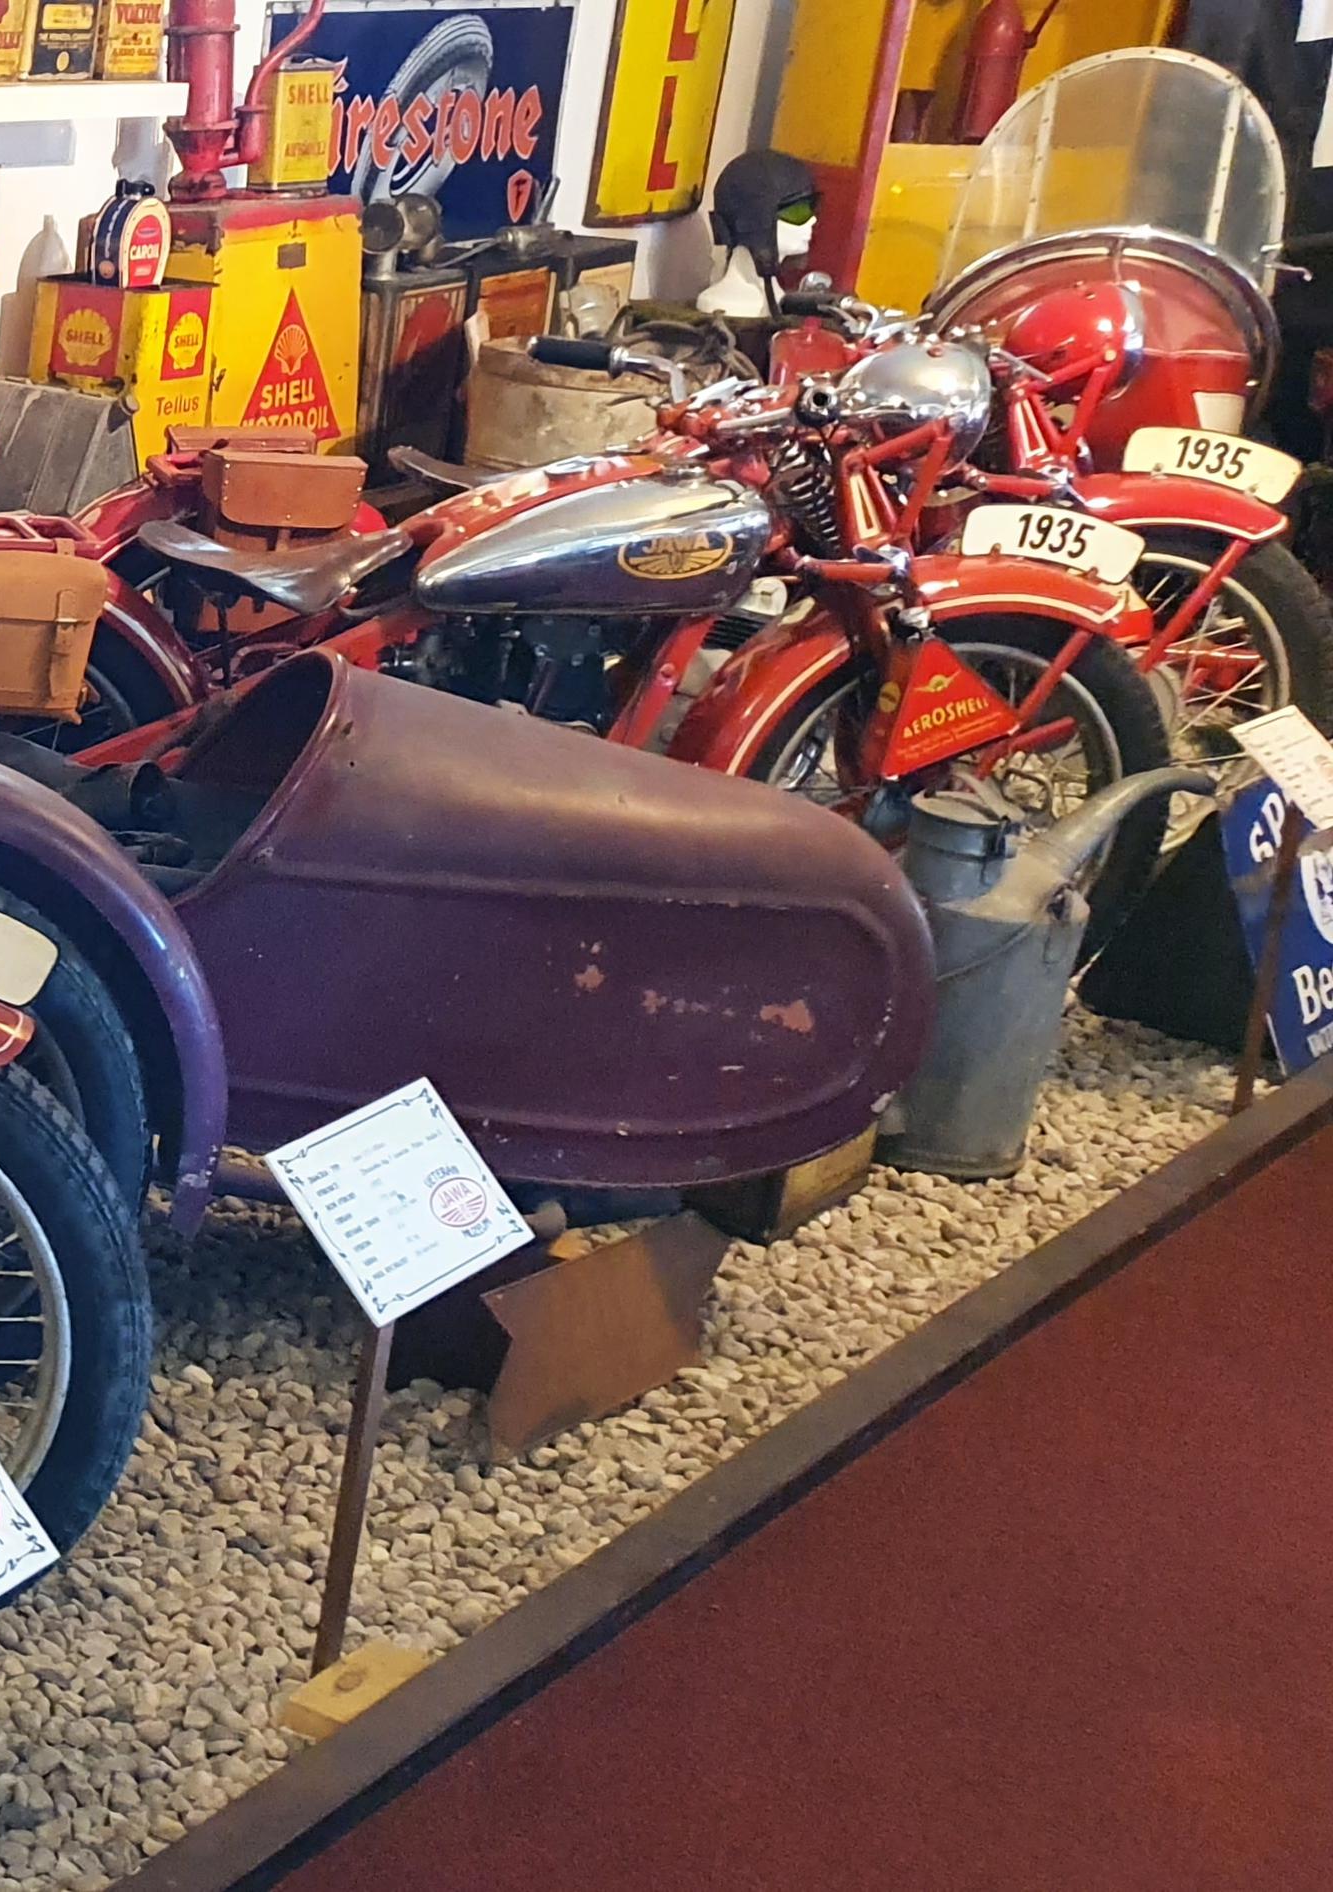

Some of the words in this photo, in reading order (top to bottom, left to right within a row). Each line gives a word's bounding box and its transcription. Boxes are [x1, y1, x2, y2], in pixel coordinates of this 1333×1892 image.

[288, 83, 330, 105] SHELL
[327, 57, 544, 177] irestone
[66, 328, 106, 346] SHELL
[174, 333, 200, 350] SHELL
[156, 395, 200, 416] Tellus
[260, 377, 315, 410] SHELL
[1175, 434, 1252, 480] 1935
[641, 533, 711, 554] JAWA
[1016, 512, 1092, 559] 1935
[438, 1181, 473, 1209] JAWA
